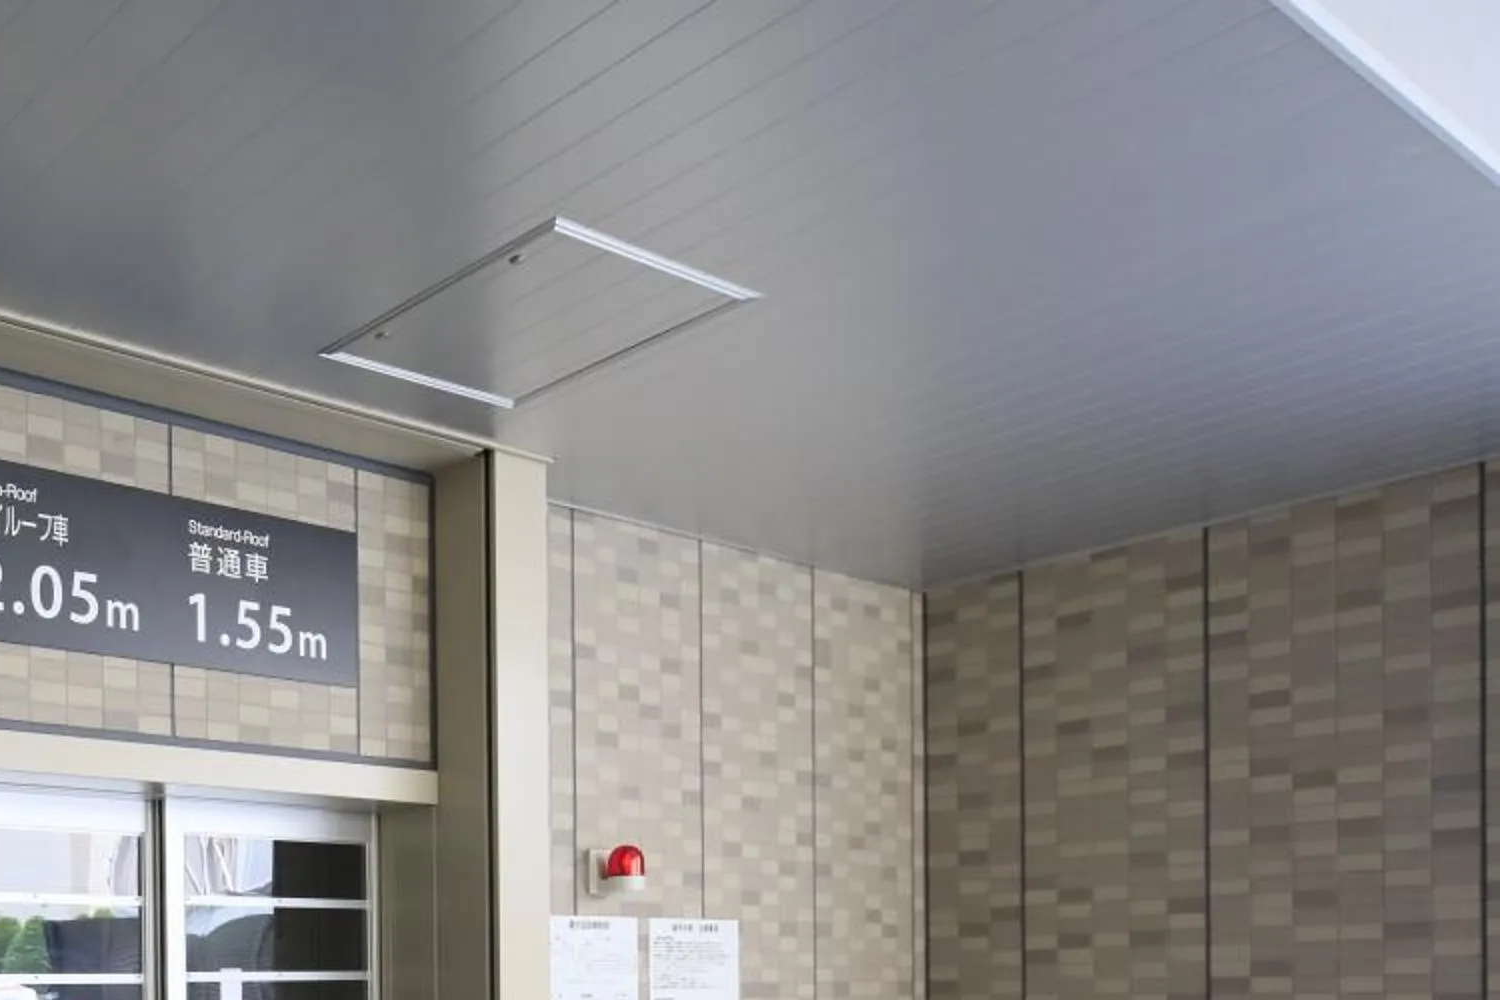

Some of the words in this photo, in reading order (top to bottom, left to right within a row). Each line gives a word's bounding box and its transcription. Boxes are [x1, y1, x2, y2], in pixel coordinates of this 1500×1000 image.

[188, 519, 270, 548] Standard-Roof
[188, 542, 269, 583] 普通車
[188, 593, 327, 661] 1.55m
